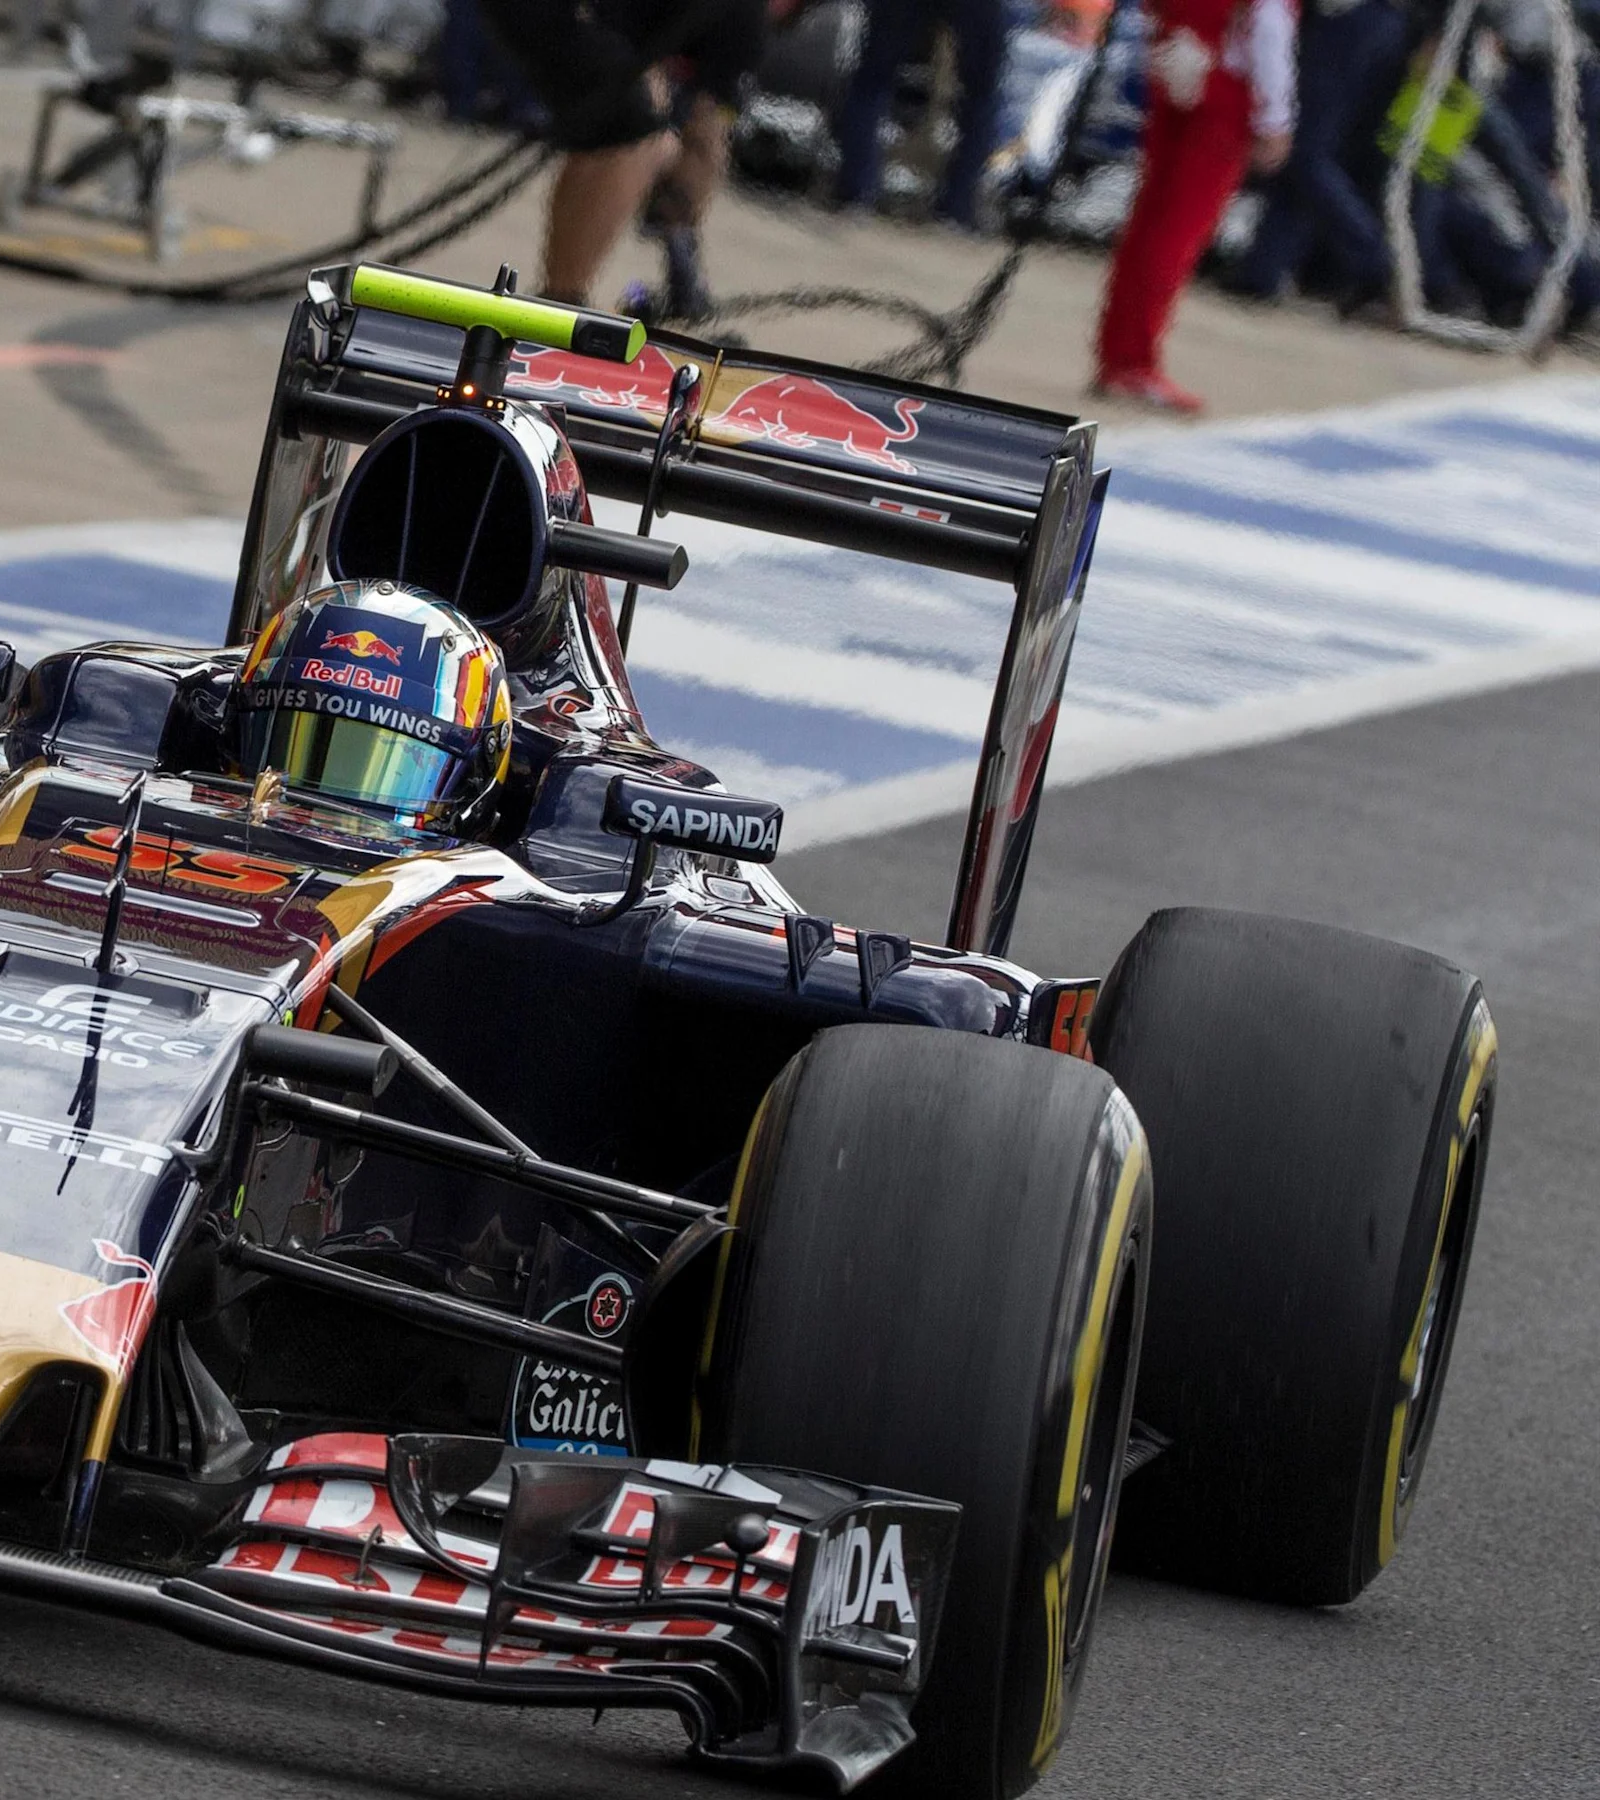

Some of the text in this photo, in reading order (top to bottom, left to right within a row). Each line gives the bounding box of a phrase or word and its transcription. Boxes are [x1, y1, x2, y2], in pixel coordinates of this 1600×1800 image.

[301, 658, 403, 700] Red Bull
[255, 687, 442, 745] GIVES YOU WINGS
[627, 799, 778, 851] SAPINDA
[59, 826, 291, 894] 55
